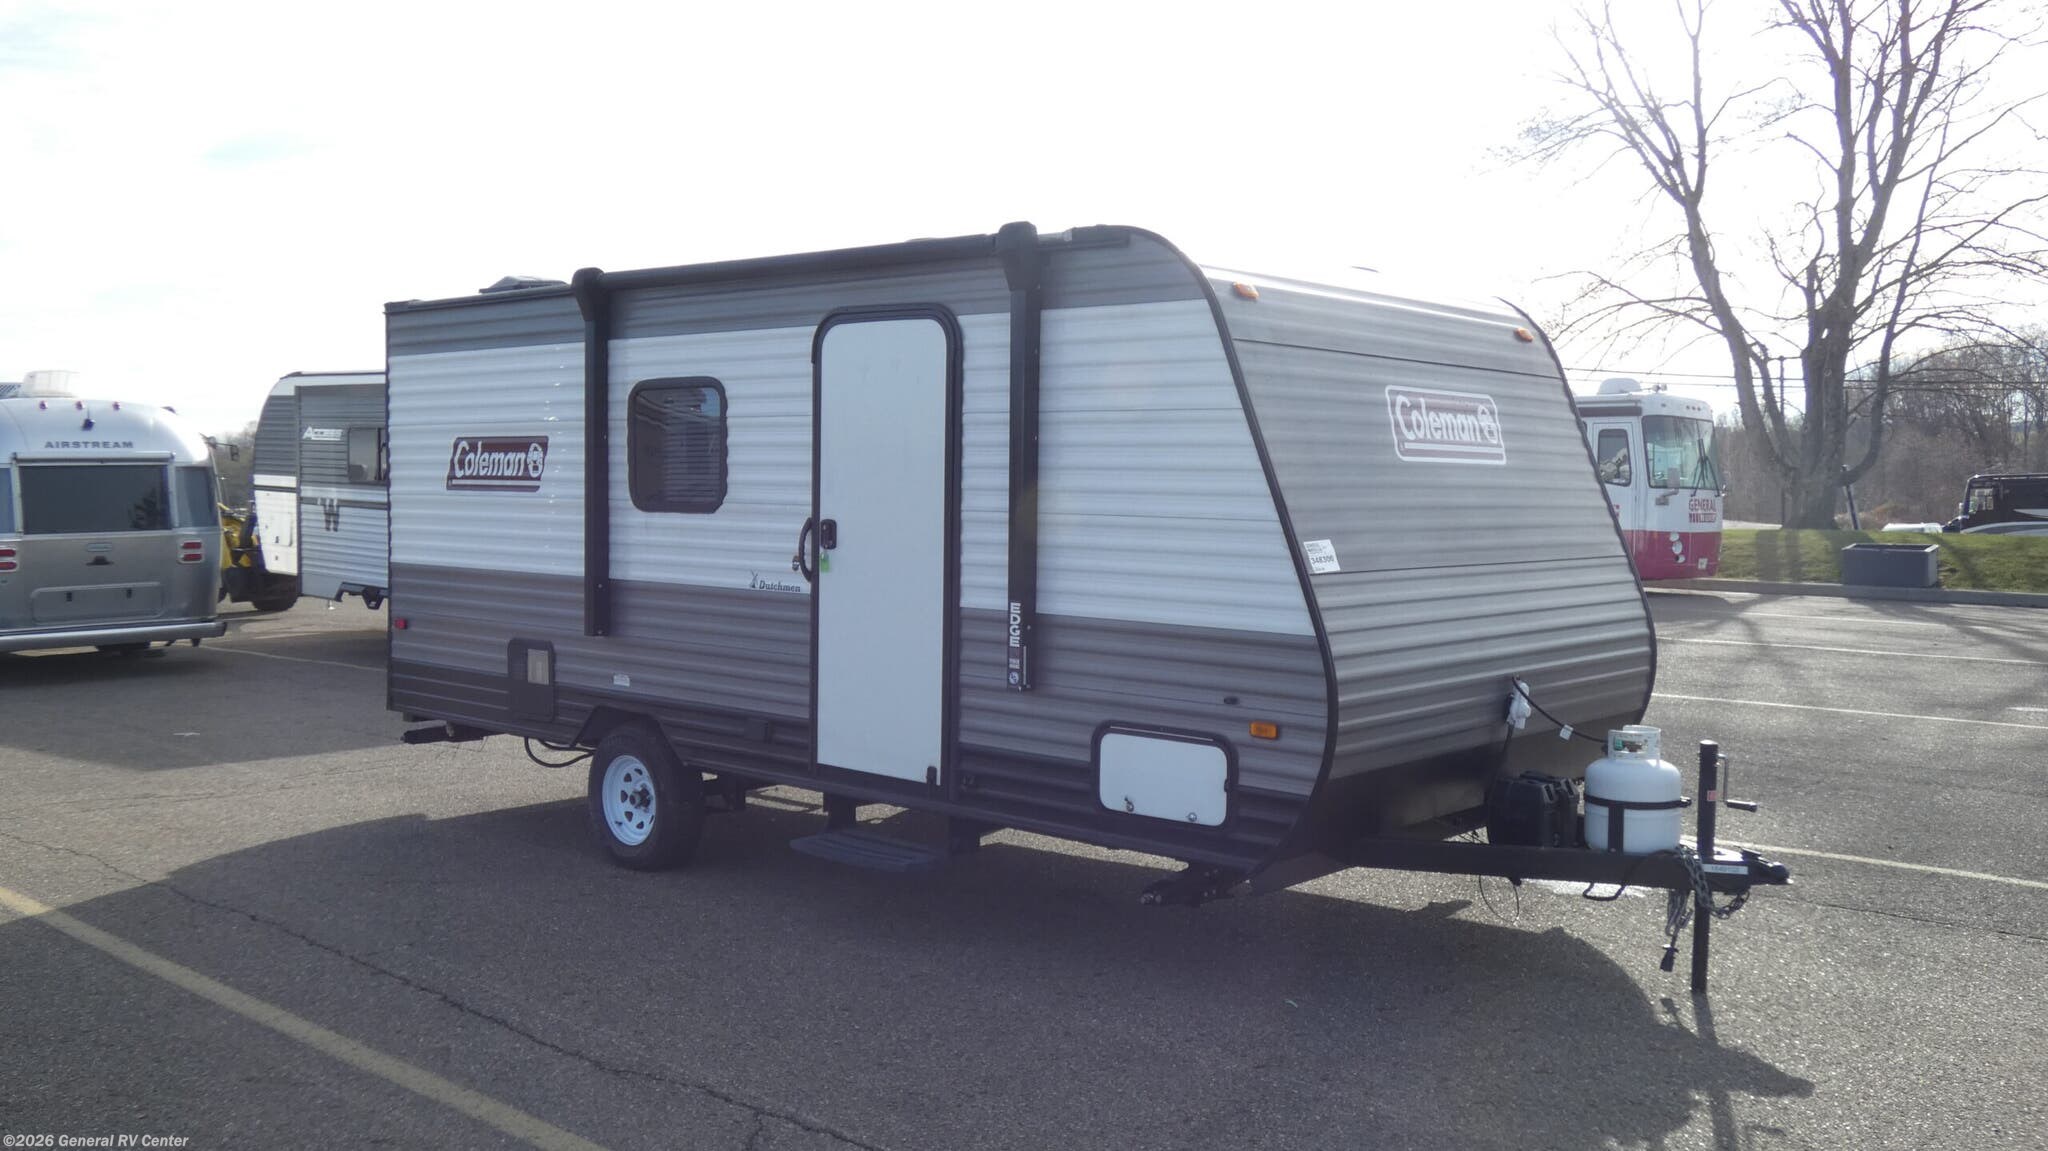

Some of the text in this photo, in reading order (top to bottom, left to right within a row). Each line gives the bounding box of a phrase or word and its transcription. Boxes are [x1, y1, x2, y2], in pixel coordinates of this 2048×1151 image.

[1395, 394, 1482, 443] Coleman
[44, 440, 134, 449] AIRSTREAM
[454, 440, 526, 478] Coleman
[759, 579, 801, 592] Dutchmen
[1009, 602, 1021, 648] EDGE
